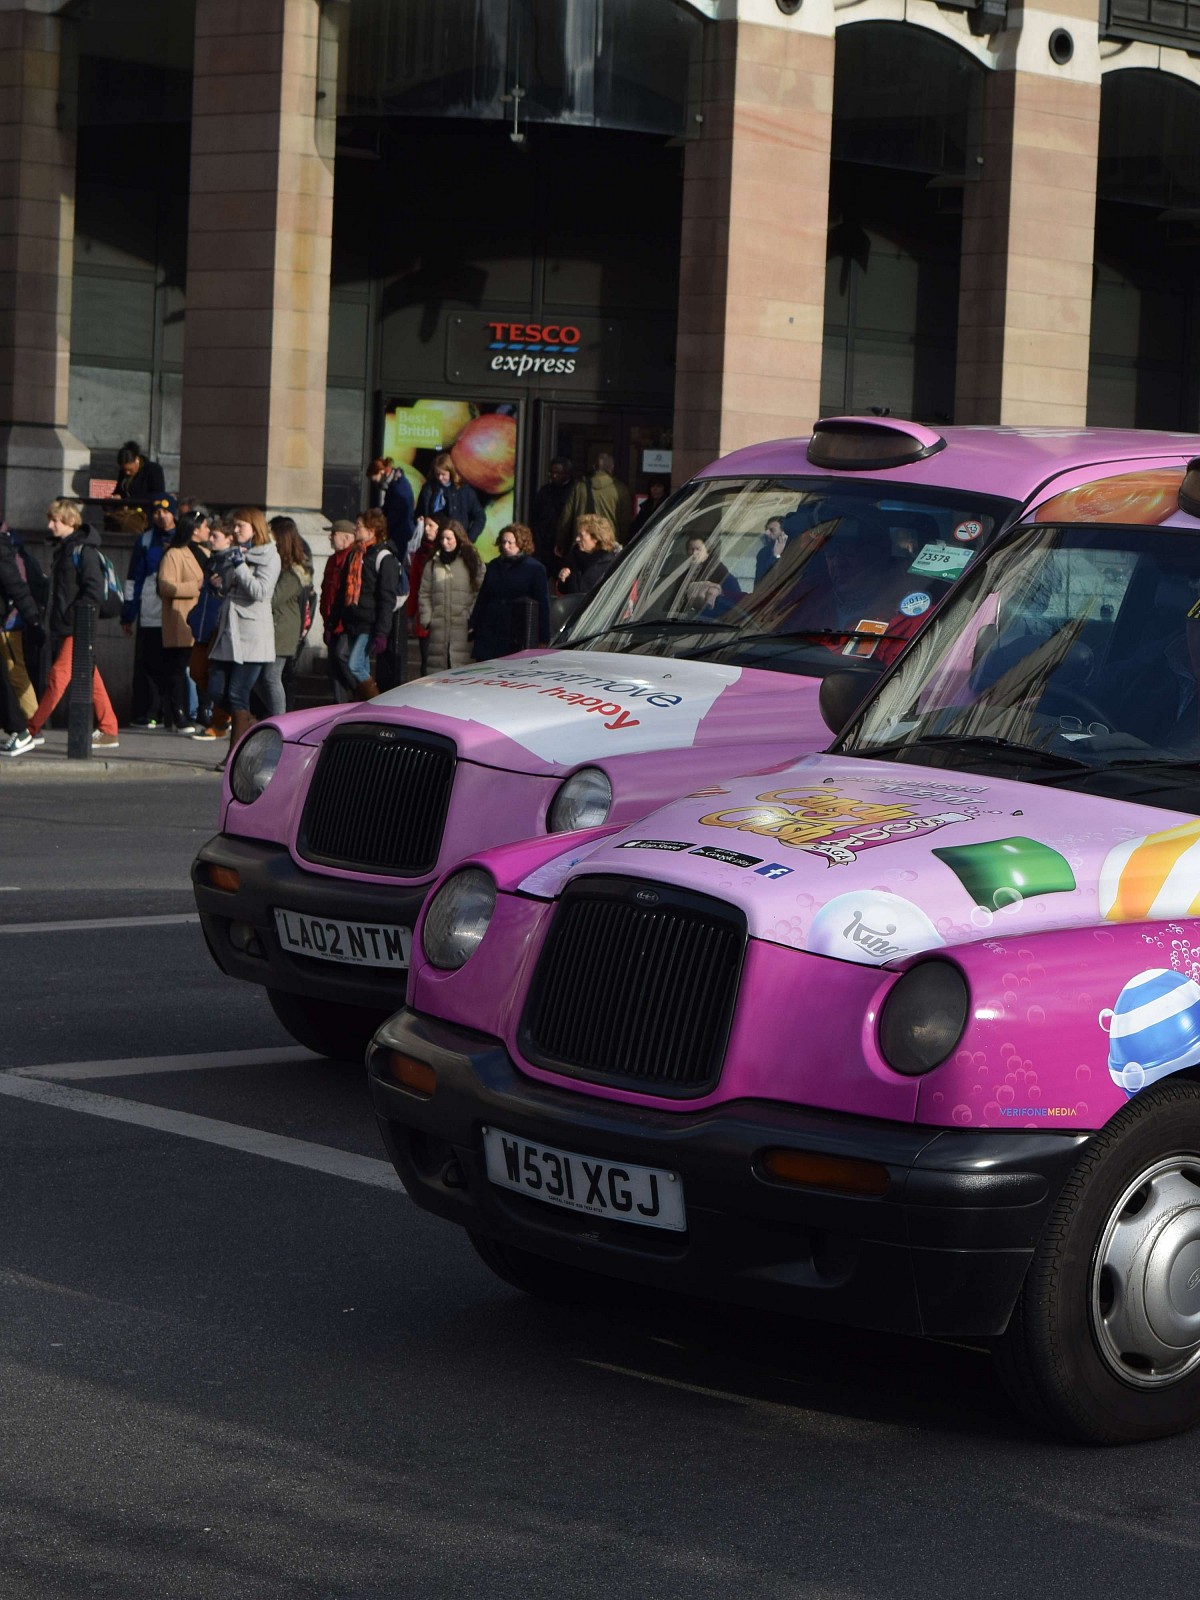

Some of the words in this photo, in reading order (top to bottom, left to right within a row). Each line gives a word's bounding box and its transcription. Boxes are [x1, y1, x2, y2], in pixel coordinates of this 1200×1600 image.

[488, 322, 581, 344] TESCO
[491, 354, 576, 376] express
[399, 411, 427, 424] Best
[399, 424, 440, 437] British
[920, 552, 951, 563] 73578
[484, 667, 683, 708] rightmove
[460, 678, 542, 690] your
[537, 686, 641, 730] happy
[811, 844, 852, 862] SAGA
[282, 913, 344, 955] LA02
[346, 925, 405, 961] NTM
[842, 910, 908, 957] King
[1000, 1107, 1077, 1117] VERIFONEMEDIA
[501, 1137, 575, 1200] W531
[581, 1161, 660, 1217] XGJ
